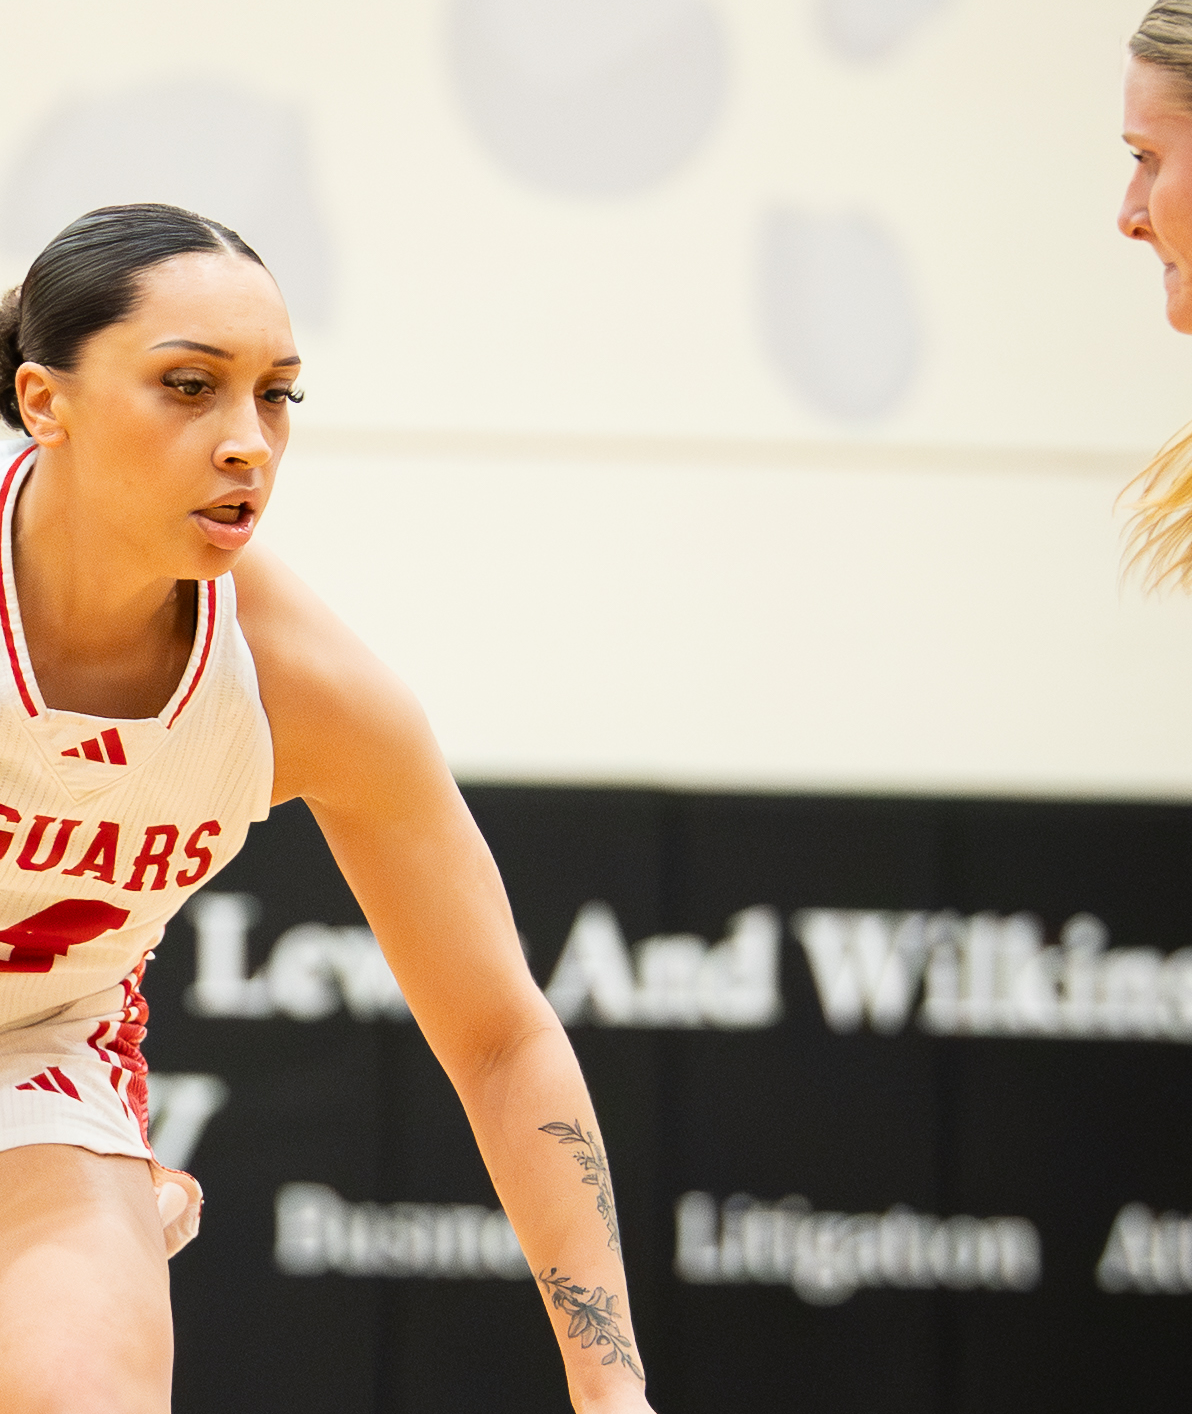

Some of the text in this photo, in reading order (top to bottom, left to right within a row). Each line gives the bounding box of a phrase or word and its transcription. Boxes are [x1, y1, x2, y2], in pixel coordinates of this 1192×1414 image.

[184, 891, 412, 1022] Lew
[543, 899, 785, 1029] And
[674, 1191, 1041, 1305] Litigation
